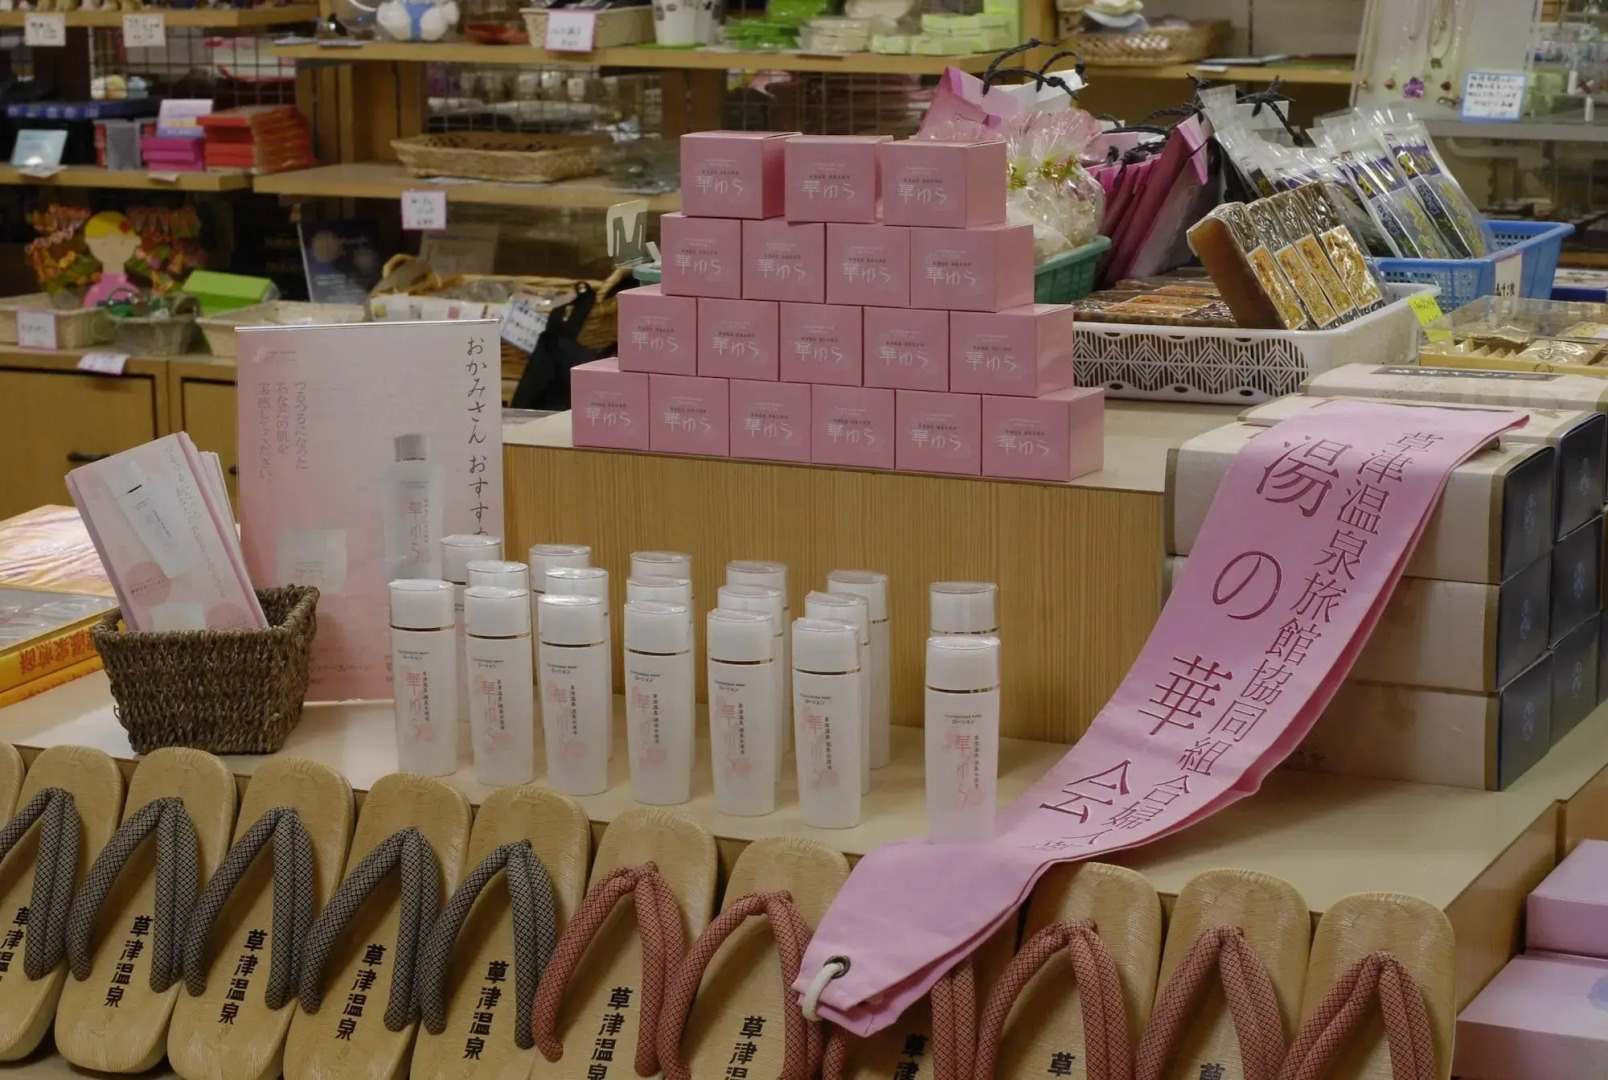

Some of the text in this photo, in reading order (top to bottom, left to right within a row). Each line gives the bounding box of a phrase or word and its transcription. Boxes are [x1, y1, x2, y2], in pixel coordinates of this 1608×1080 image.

[466, 336, 488, 446] おかみさん
[0, 906, 31, 981] 草津温
[104, 915, 152, 1008] 草津温泉
[217, 929, 268, 1025] 草津温泉
[334, 944, 387, 1040] 草津温泉
[463, 961, 511, 1059] 草津温泉
[1047, 1052, 1076, 1077] 草
